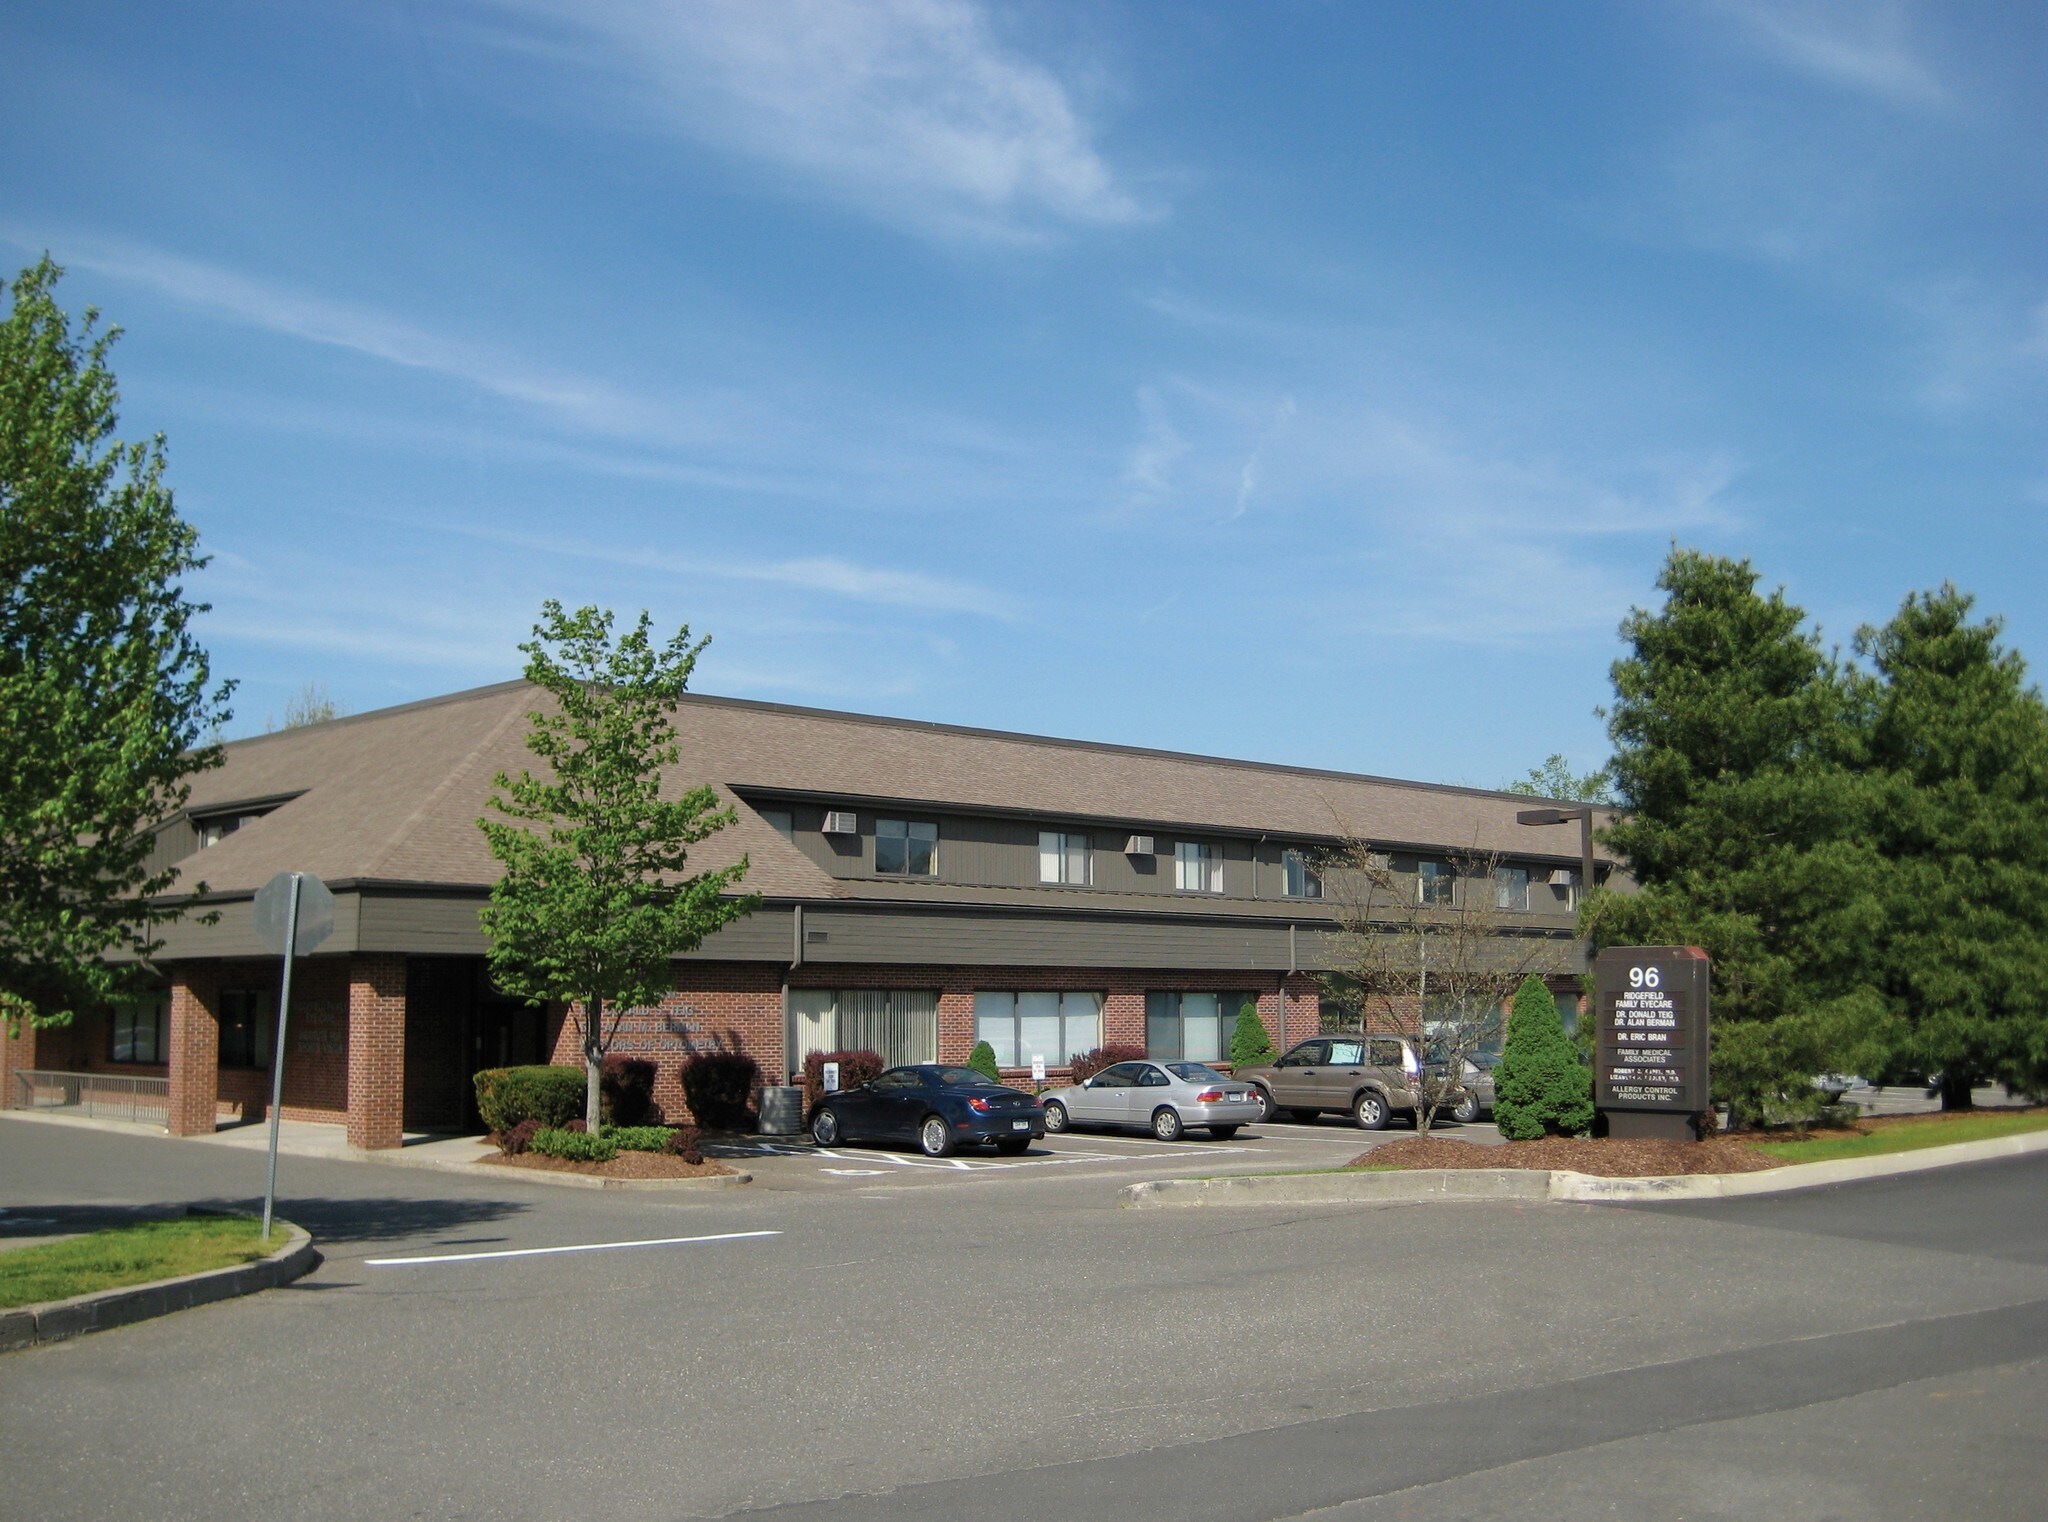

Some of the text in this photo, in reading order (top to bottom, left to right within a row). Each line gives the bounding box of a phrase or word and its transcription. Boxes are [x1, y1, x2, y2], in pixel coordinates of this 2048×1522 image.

[1629, 967, 1660, 988] 96
[1623, 991, 1664, 1000] RIDGEFIELD
[1615, 1000, 1673, 1008] FAMILY EYECARE
[1616, 1010, 1627, 1018] DR.
[1628, 1010, 1656, 1018] DONALD
[1646, 1019, 1676, 1027] BERMAN
[1617, 1032, 1667, 1042] DR. ERIC BRAN
